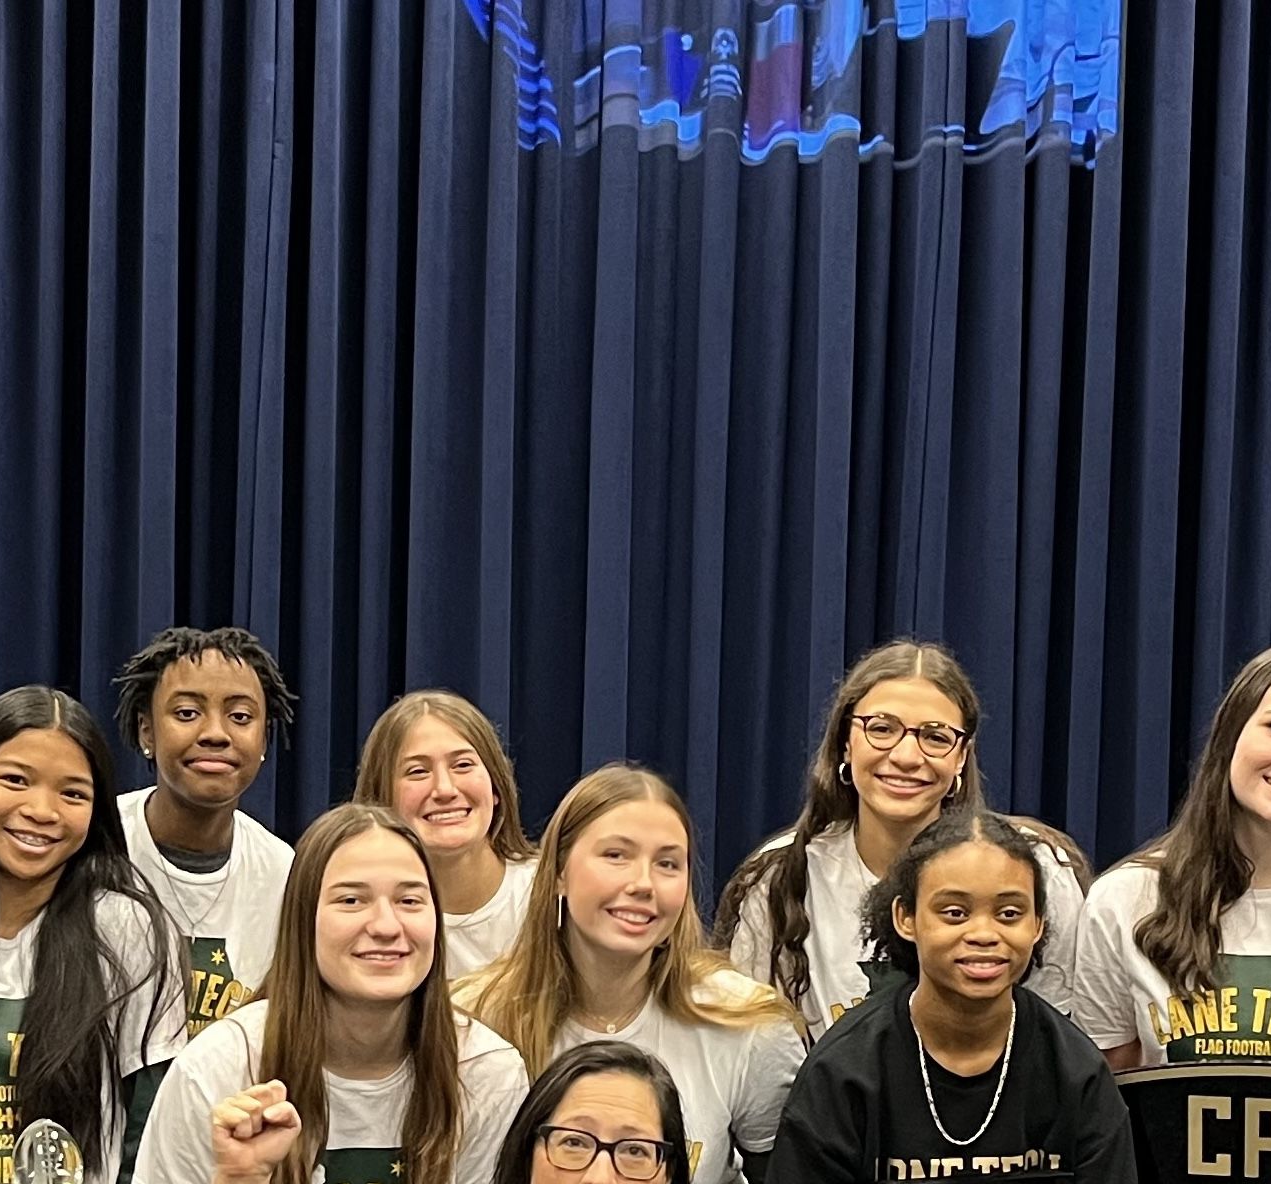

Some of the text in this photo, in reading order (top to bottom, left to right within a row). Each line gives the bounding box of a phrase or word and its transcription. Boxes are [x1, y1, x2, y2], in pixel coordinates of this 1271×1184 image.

[187, 969, 253, 1020] TEC
[1148, 987, 1238, 1046] LANE
[1195, 1038, 1224, 1055] FLAG
